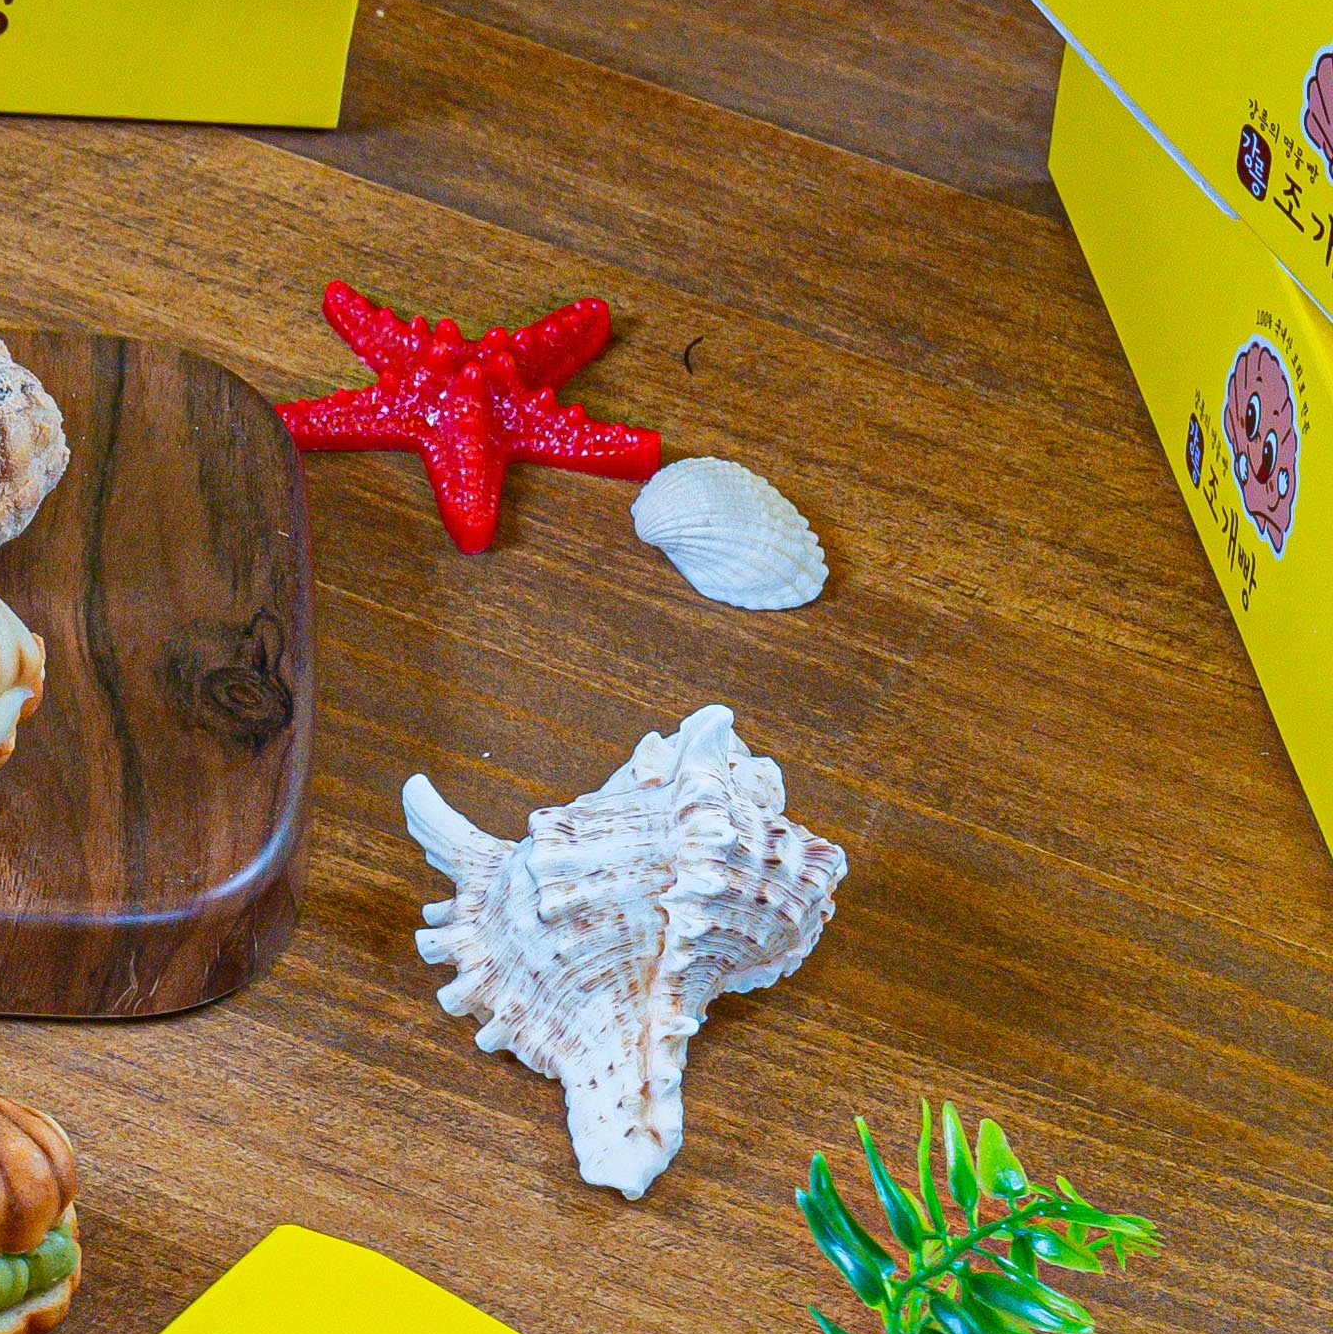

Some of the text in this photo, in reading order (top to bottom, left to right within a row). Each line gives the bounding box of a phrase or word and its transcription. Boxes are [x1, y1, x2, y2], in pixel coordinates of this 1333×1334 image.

[1243, 132, 1266, 195] 강릉
[1249, 99, 1319, 184] 강릉의 명물 빵
